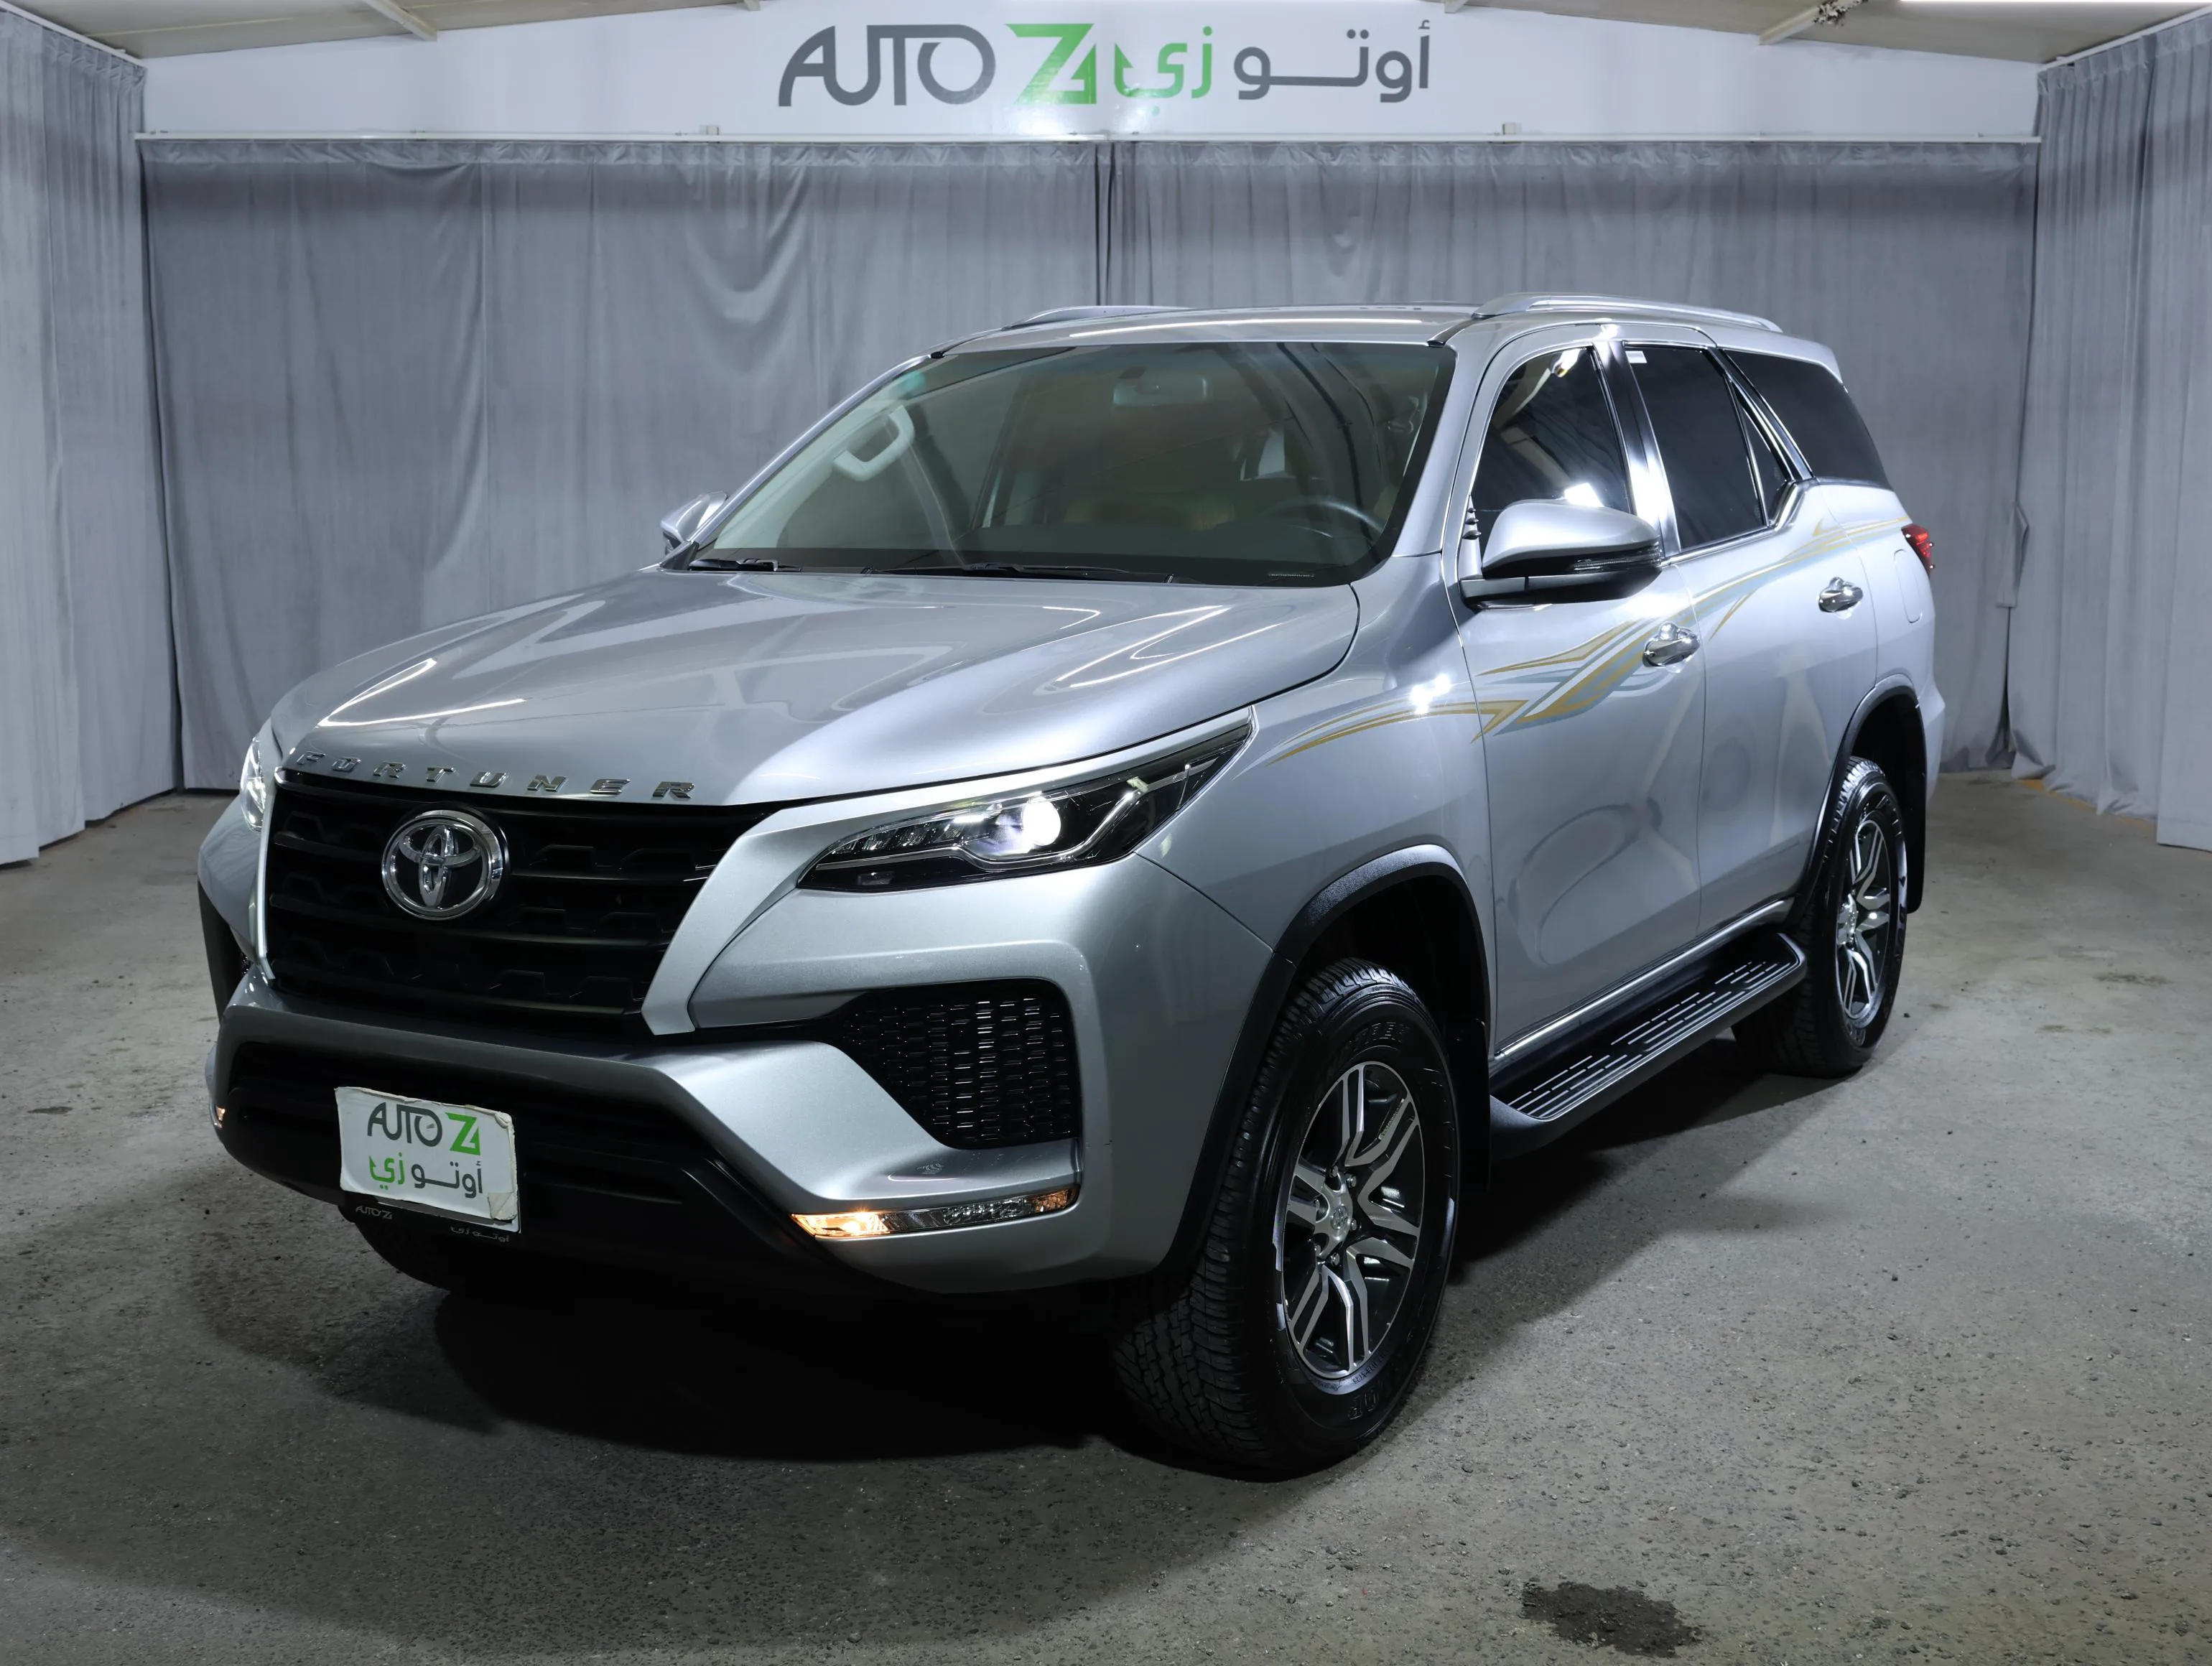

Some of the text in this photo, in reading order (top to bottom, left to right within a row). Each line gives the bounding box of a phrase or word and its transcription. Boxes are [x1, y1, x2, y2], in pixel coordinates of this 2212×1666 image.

[778, 24, 996, 107] AUTO
[1113, 19, 1431, 116] أوتو زي
[296, 750, 696, 799] FORTUNER
[367, 1102, 443, 1148] AUTO
[368, 1152, 483, 1199] أوتو زي
[355, 1205, 381, 1218] AUTO
